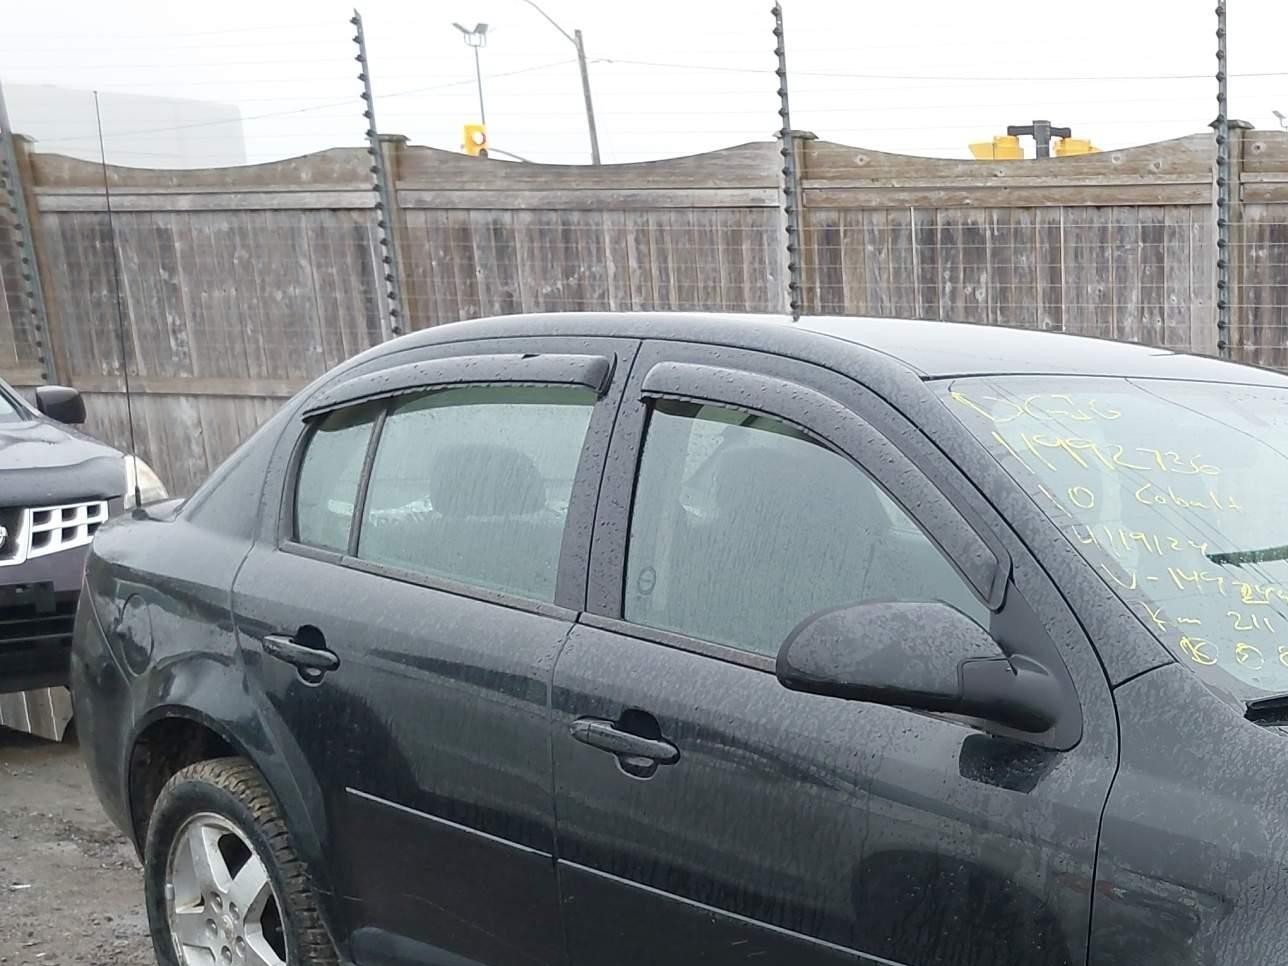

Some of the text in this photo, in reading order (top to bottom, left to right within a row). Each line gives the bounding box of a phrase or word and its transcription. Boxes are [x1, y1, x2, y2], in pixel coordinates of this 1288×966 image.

[991, 431, 1223, 475] 11992736
[1038, 483, 1243, 518] 10 Cobalt
[1226, 611, 1276, 633] 211
